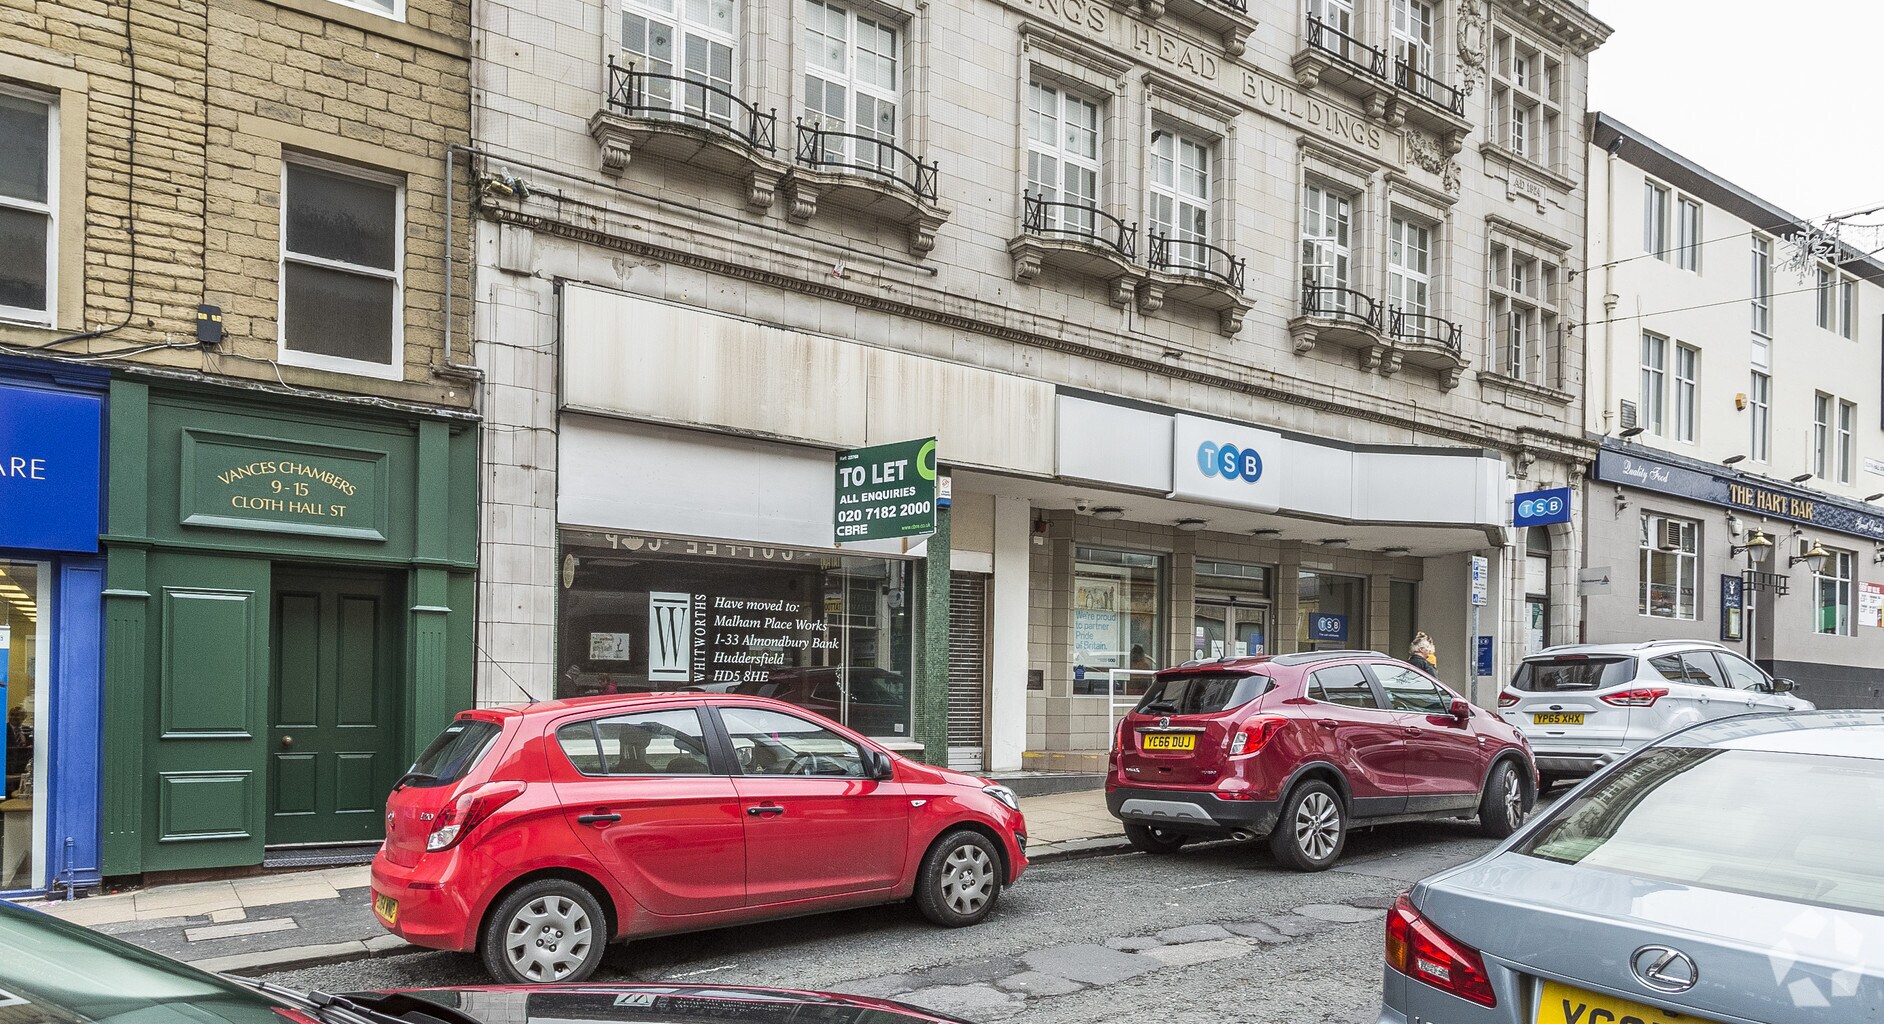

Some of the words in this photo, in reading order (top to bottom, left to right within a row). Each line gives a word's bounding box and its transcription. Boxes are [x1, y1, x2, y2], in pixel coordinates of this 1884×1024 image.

[1133, 22, 1218, 81] HEAD
[1241, 71, 1381, 150] BUILDINGS
[1202, 445, 1259, 479] TSB
[217, 461, 277, 484] VANCES
[279, 461, 357, 496] CHAMBERS
[840, 466, 866, 487] TO
[872, 459, 908, 484] LET
[1623, 459, 1648, 483] Quality
[1650, 466, 1670, 483] Food
[840, 494, 859, 504] ALL
[861, 486, 916, 502] ENQUIRIES
[1730, 484, 1753, 506] THE
[1757, 489, 1787, 513] HART
[1791, 496, 1815, 520] BAR
[232, 496, 284, 511] CLOTH
[289, 501, 325, 515] HALL
[330, 504, 346, 517] ST
[838, 509, 862, 523] 020
[865, 505, 896, 520] 7182
[900, 500, 931, 516] 2000
[1521, 499, 1560, 516] TSB
[837, 524, 868, 536] CBRE
[714, 597, 744, 610] Have
[746, 600, 783, 612] moved
[785, 602, 800, 612] to:
[714, 615, 761, 628] Malham
[764, 617, 792, 630] Place
[795, 619, 828, 631] Works
[1075, 610, 1096, 621] We're
[1096, 613, 1116, 624] proud
[1319, 618, 1340, 631] TSB
[653, 606, 688, 666] W
[1075, 631, 1094, 640] Pride
[1084, 623, 1110, 632] partner
[694, 594, 707, 682] WHITWORTHS
[714, 634, 739, 645] 1-33
[742, 637, 809, 651] Almondbury
[812, 638, 839, 649] Bank
[1075, 641, 1083, 649] of
[1084, 641, 1107, 650] Britain.
[714, 652, 784, 666] Huddersfield
[714, 670, 740, 682] HD5
[743, 671, 769, 682] 8HE
[1537, 714, 1560, 723] YP65
[1562, 714, 1581, 723] XHX
[1148, 736, 1169, 747] YC66
[1172, 736, 1191, 748] DUJ
